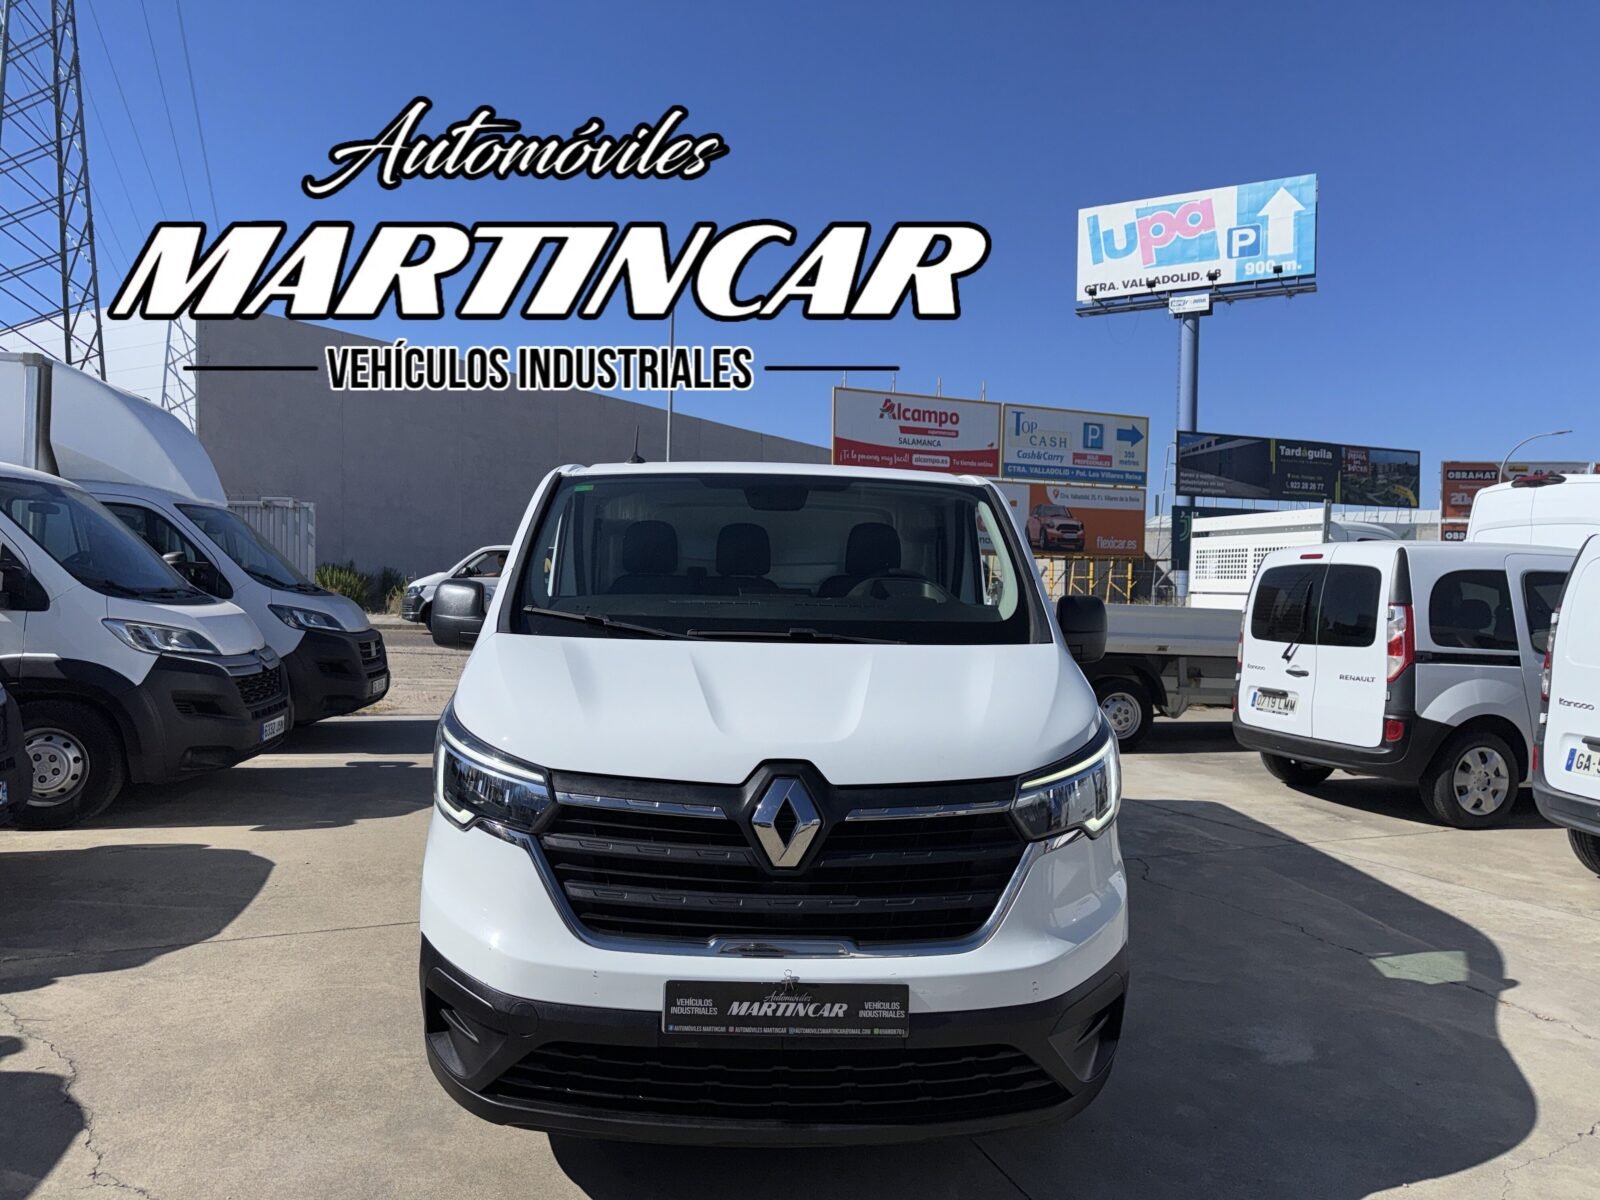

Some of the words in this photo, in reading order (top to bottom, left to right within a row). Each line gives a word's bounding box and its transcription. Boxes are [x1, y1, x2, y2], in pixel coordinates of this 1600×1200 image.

[1087, 198, 1216, 266] lupa
[1231, 228, 1257, 258] P
[1244, 259, 1276, 275] 900
[879, 399, 960, 427] Alcampo
[898, 437, 942, 447] SALAMANCA
[1029, 435, 1067, 449] CASH
[1016, 449, 1065, 463] Cash&Carry
[1029, 466, 1070, 477] VALLADOLID
[1447, 471, 1497, 481] OBRAMAT
[1446, 530, 1466, 540] OBR
[1096, 536, 1137, 549] flexicar.es
[1339, 673, 1376, 683] RENAULT
[676, 997, 713, 1007] VEHÍCULOS
[864, 1000, 901, 1010] VEHÍCULOS
[670, 1006, 718, 1015] INDUSTRIALES
[727, 1001, 848, 1018] MARTINCAR
[858, 1010, 905, 1018] INDUSTRIALES
